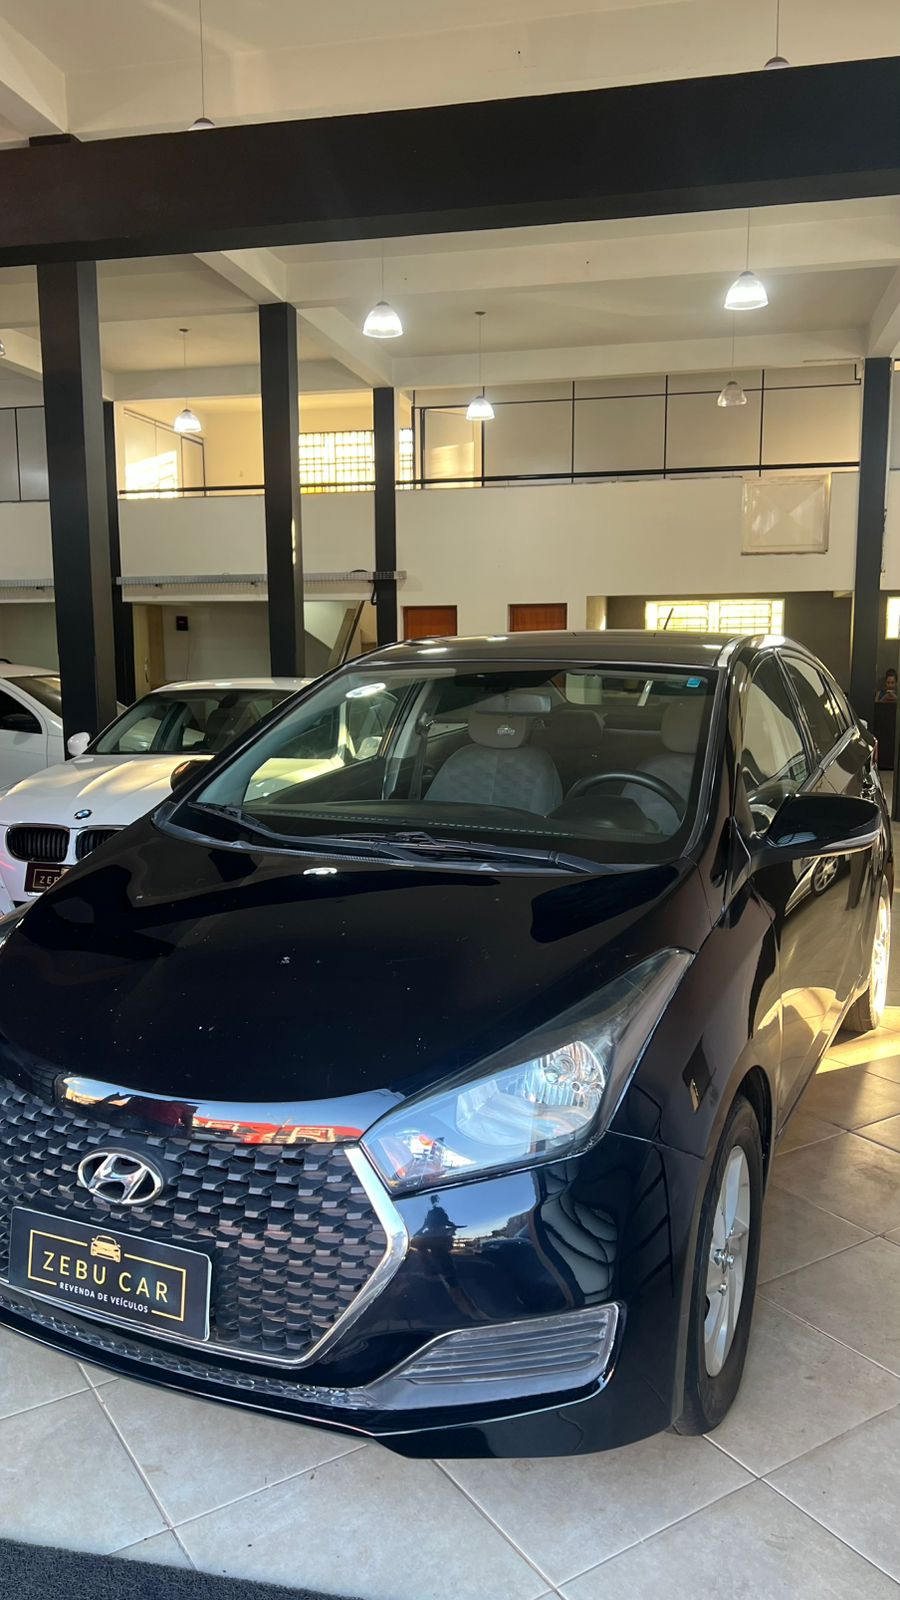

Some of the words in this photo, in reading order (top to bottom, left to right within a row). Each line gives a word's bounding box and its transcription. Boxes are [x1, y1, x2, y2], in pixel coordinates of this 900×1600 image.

[42, 1251, 107, 1285] ZEBU
[118, 1271, 168, 1303] CAR
[59, 1281, 96, 1299] REVENDA
[97, 1292, 109, 1302] DE
[110, 1295, 149, 1314] VEÍCULOS
